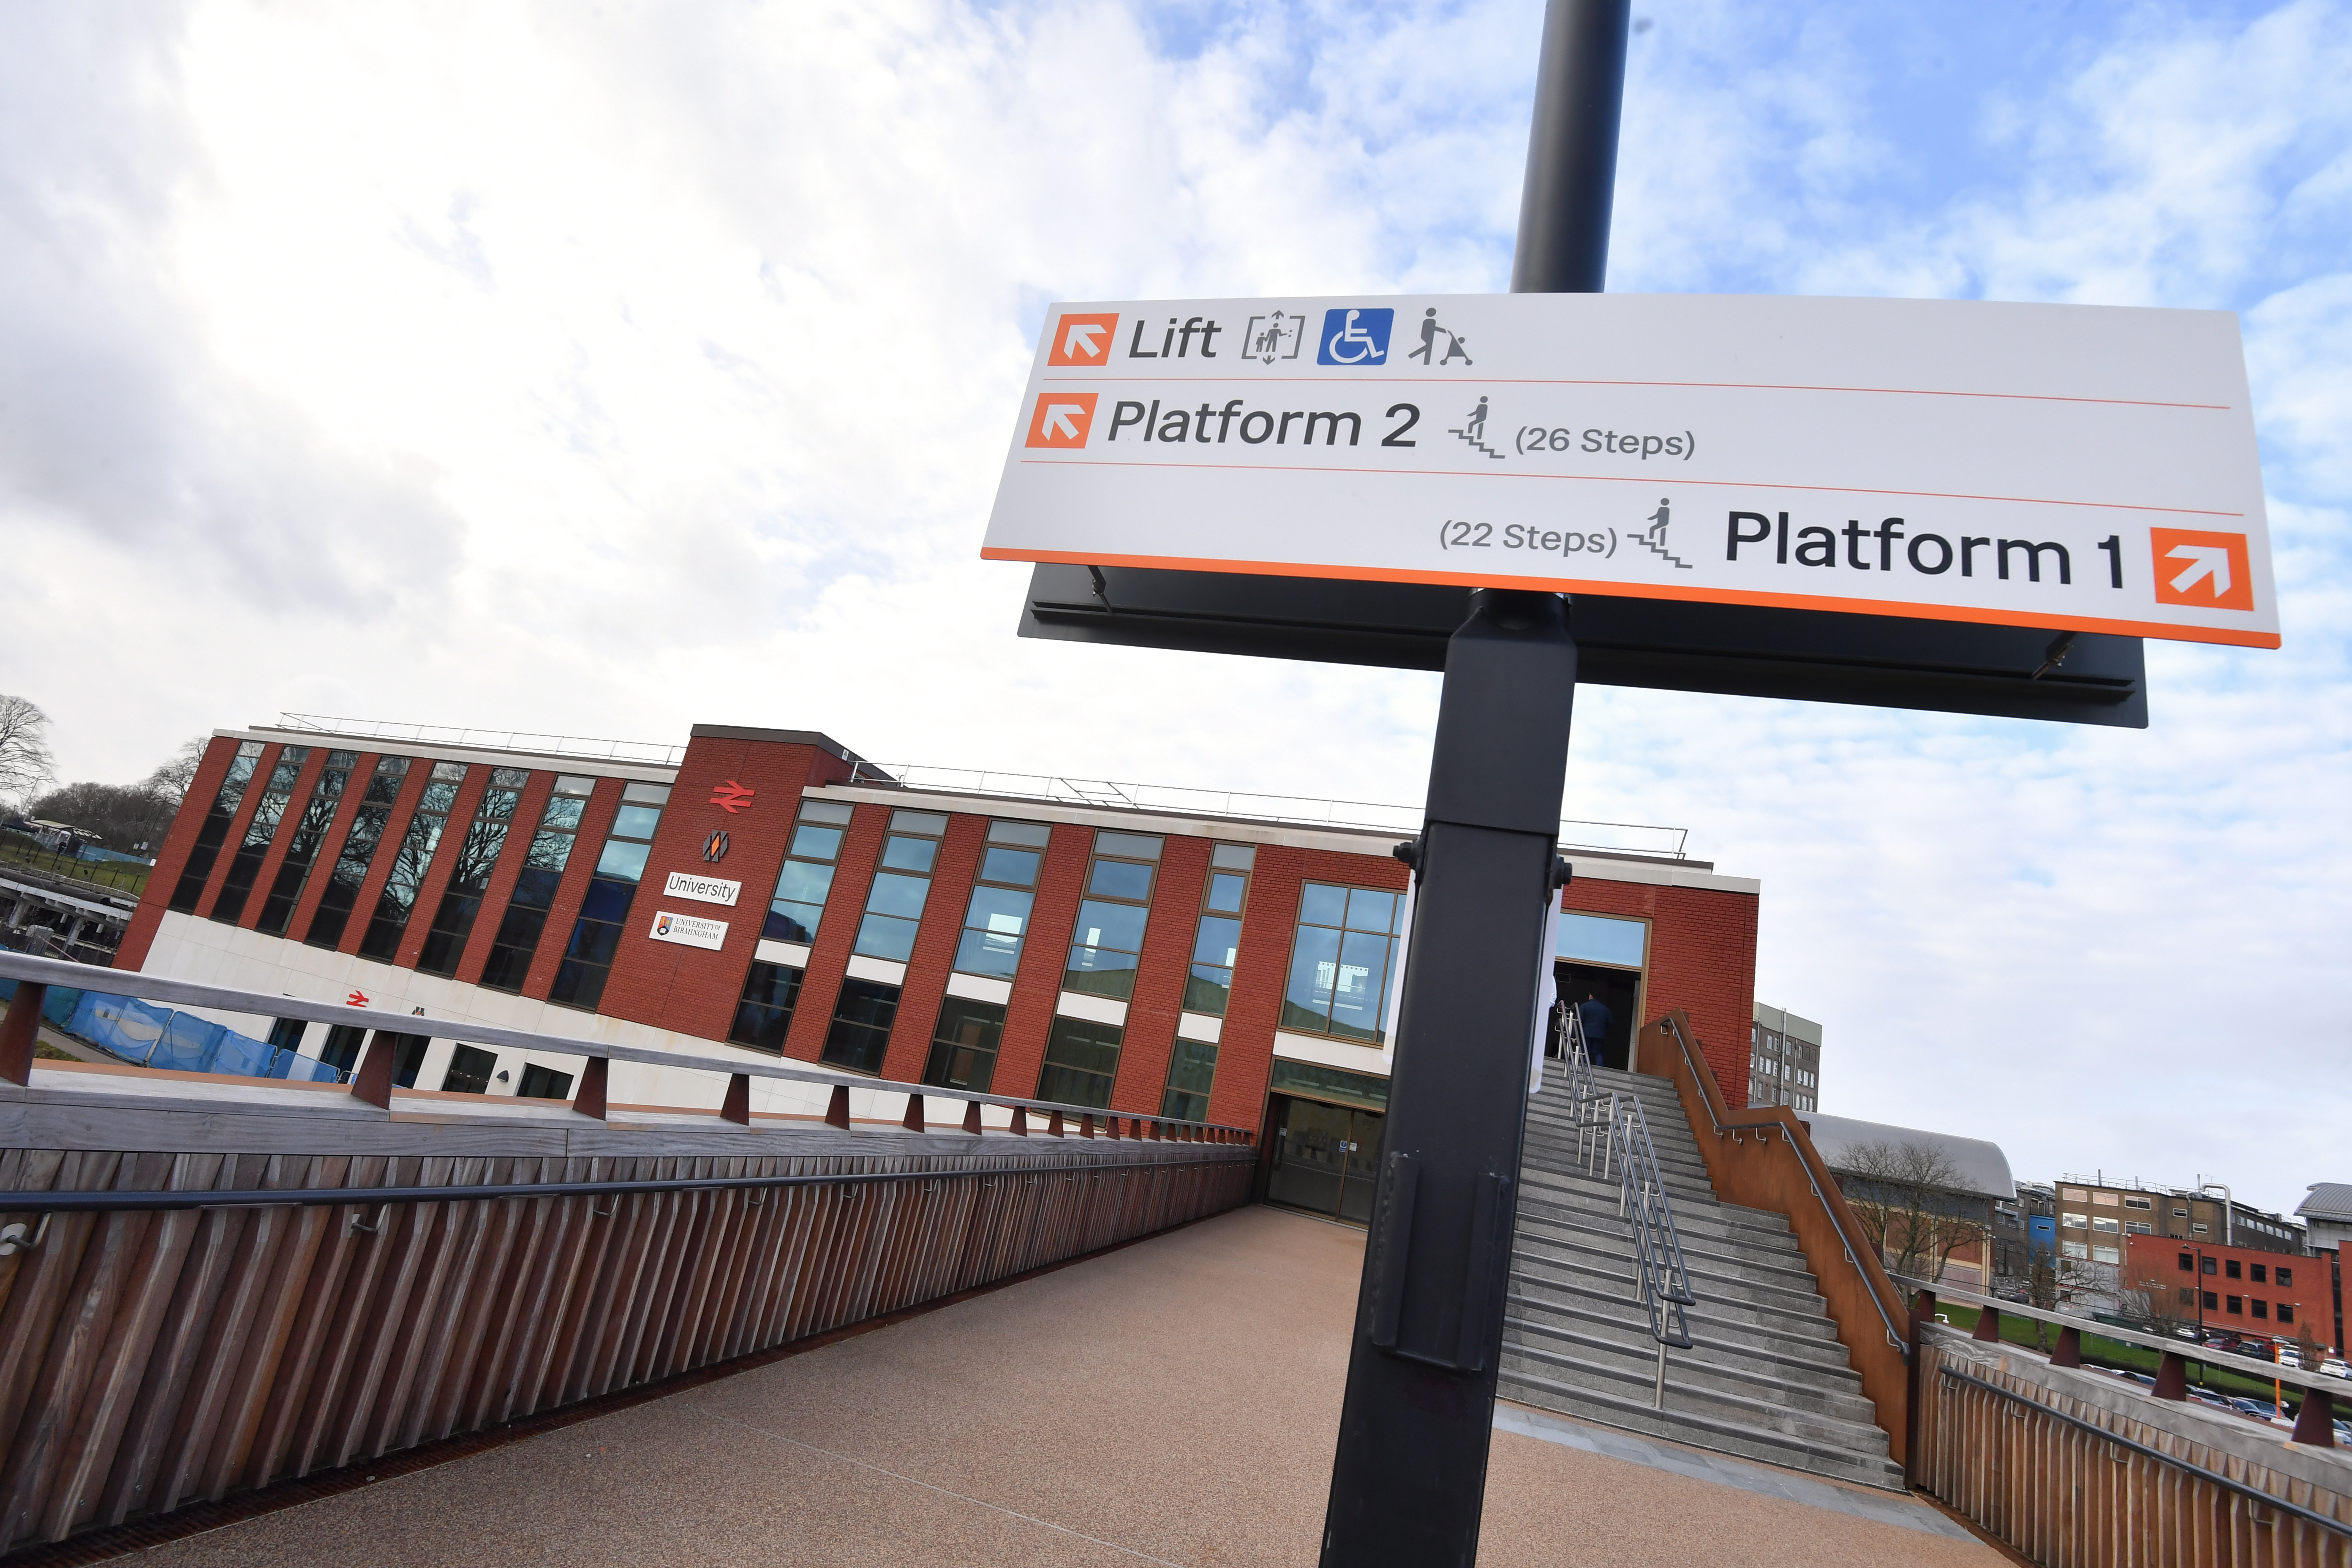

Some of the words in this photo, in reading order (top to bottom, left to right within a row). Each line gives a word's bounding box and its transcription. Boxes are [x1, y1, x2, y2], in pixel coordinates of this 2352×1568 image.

[1129, 317, 1222, 358] Lift
[1108, 400, 1361, 446] Platform
[1381, 403, 1420, 447] 2
[1516, 426, 1570, 455] (26
[1581, 429, 1694, 460] Steps)
[1440, 520, 1492, 550] (22
[1503, 524, 1617, 558] Steps)
[1727, 511, 2071, 585] Platform
[2098, 535, 2123, 588] 1
[669, 875, 736, 902] University
[673, 926, 719, 939] BIRMINGHAM
[676, 918, 714, 930] UNIVERSITY
